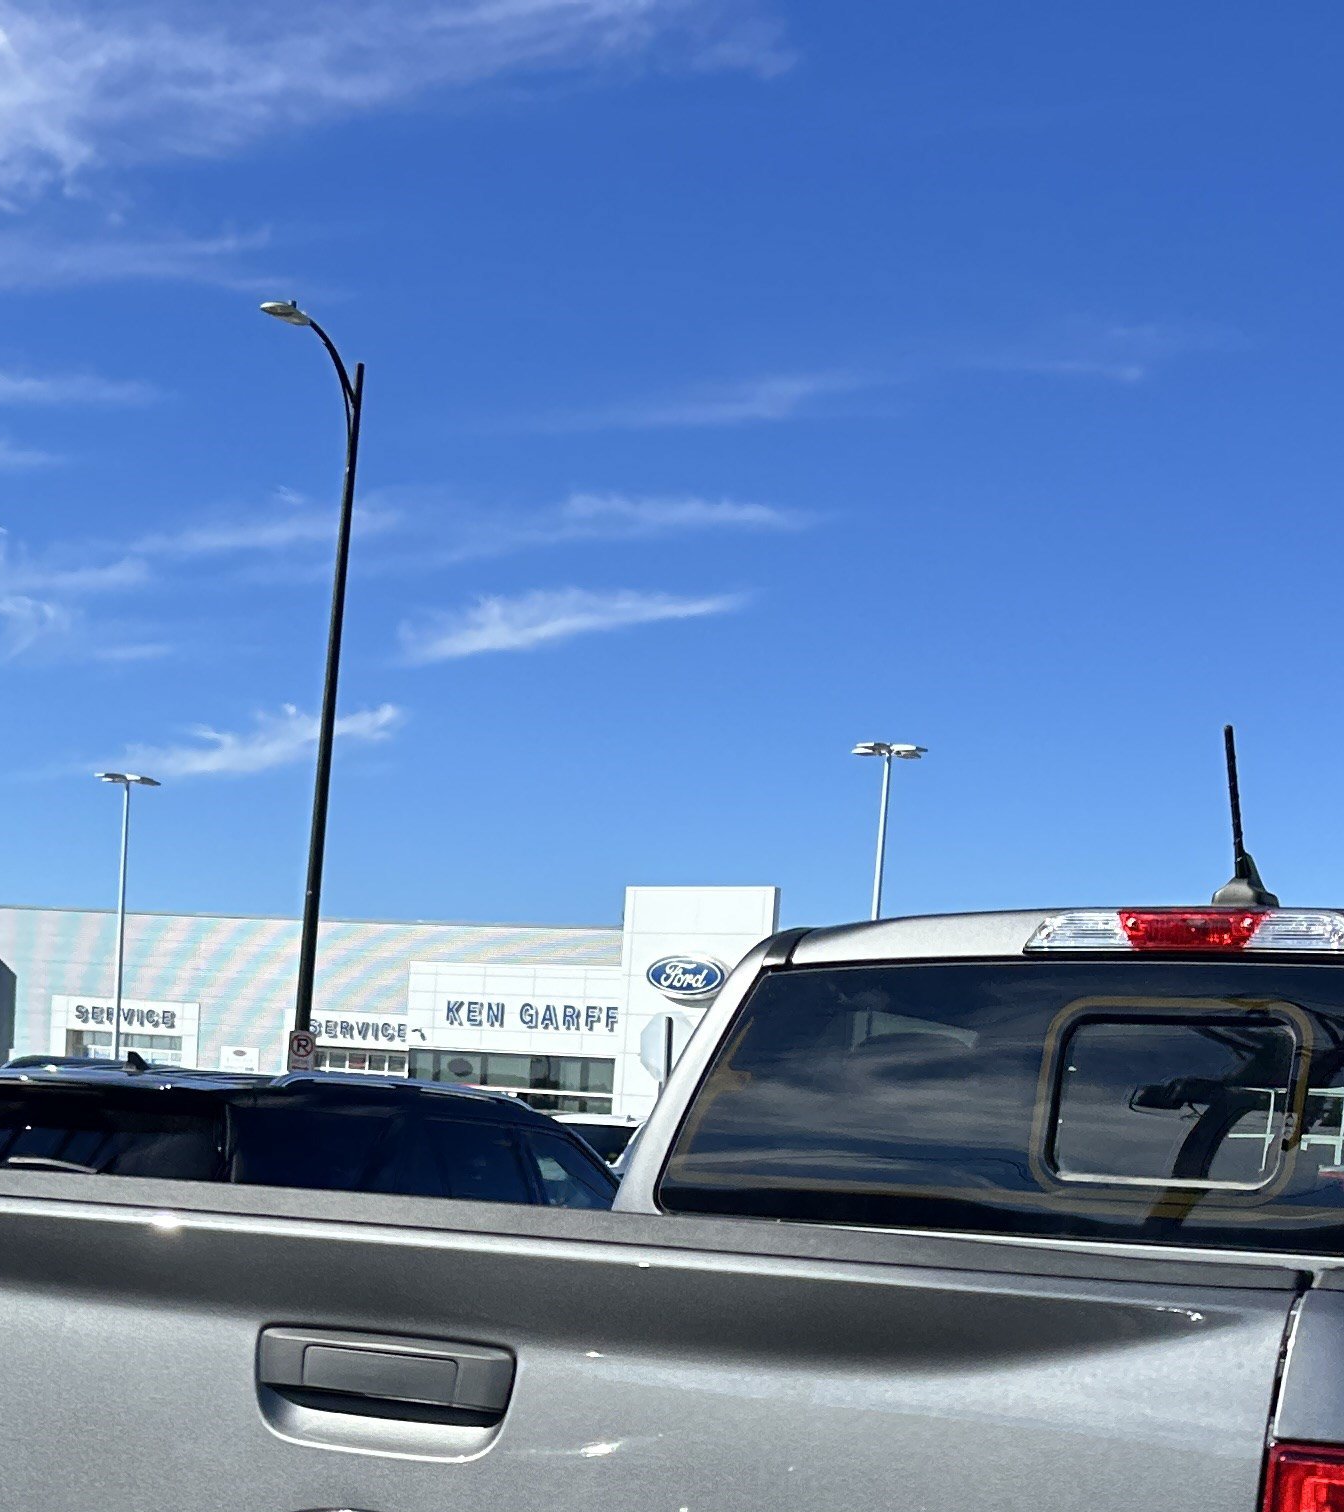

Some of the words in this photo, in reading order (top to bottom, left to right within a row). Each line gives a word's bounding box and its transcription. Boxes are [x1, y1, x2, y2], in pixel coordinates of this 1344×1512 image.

[660, 961, 709, 988] Ford
[75, 1004, 176, 1028] SERVICE
[446, 1000, 505, 1027] KEN
[519, 1002, 619, 1032] GARFF
[309, 1018, 408, 1041] SERVICE
